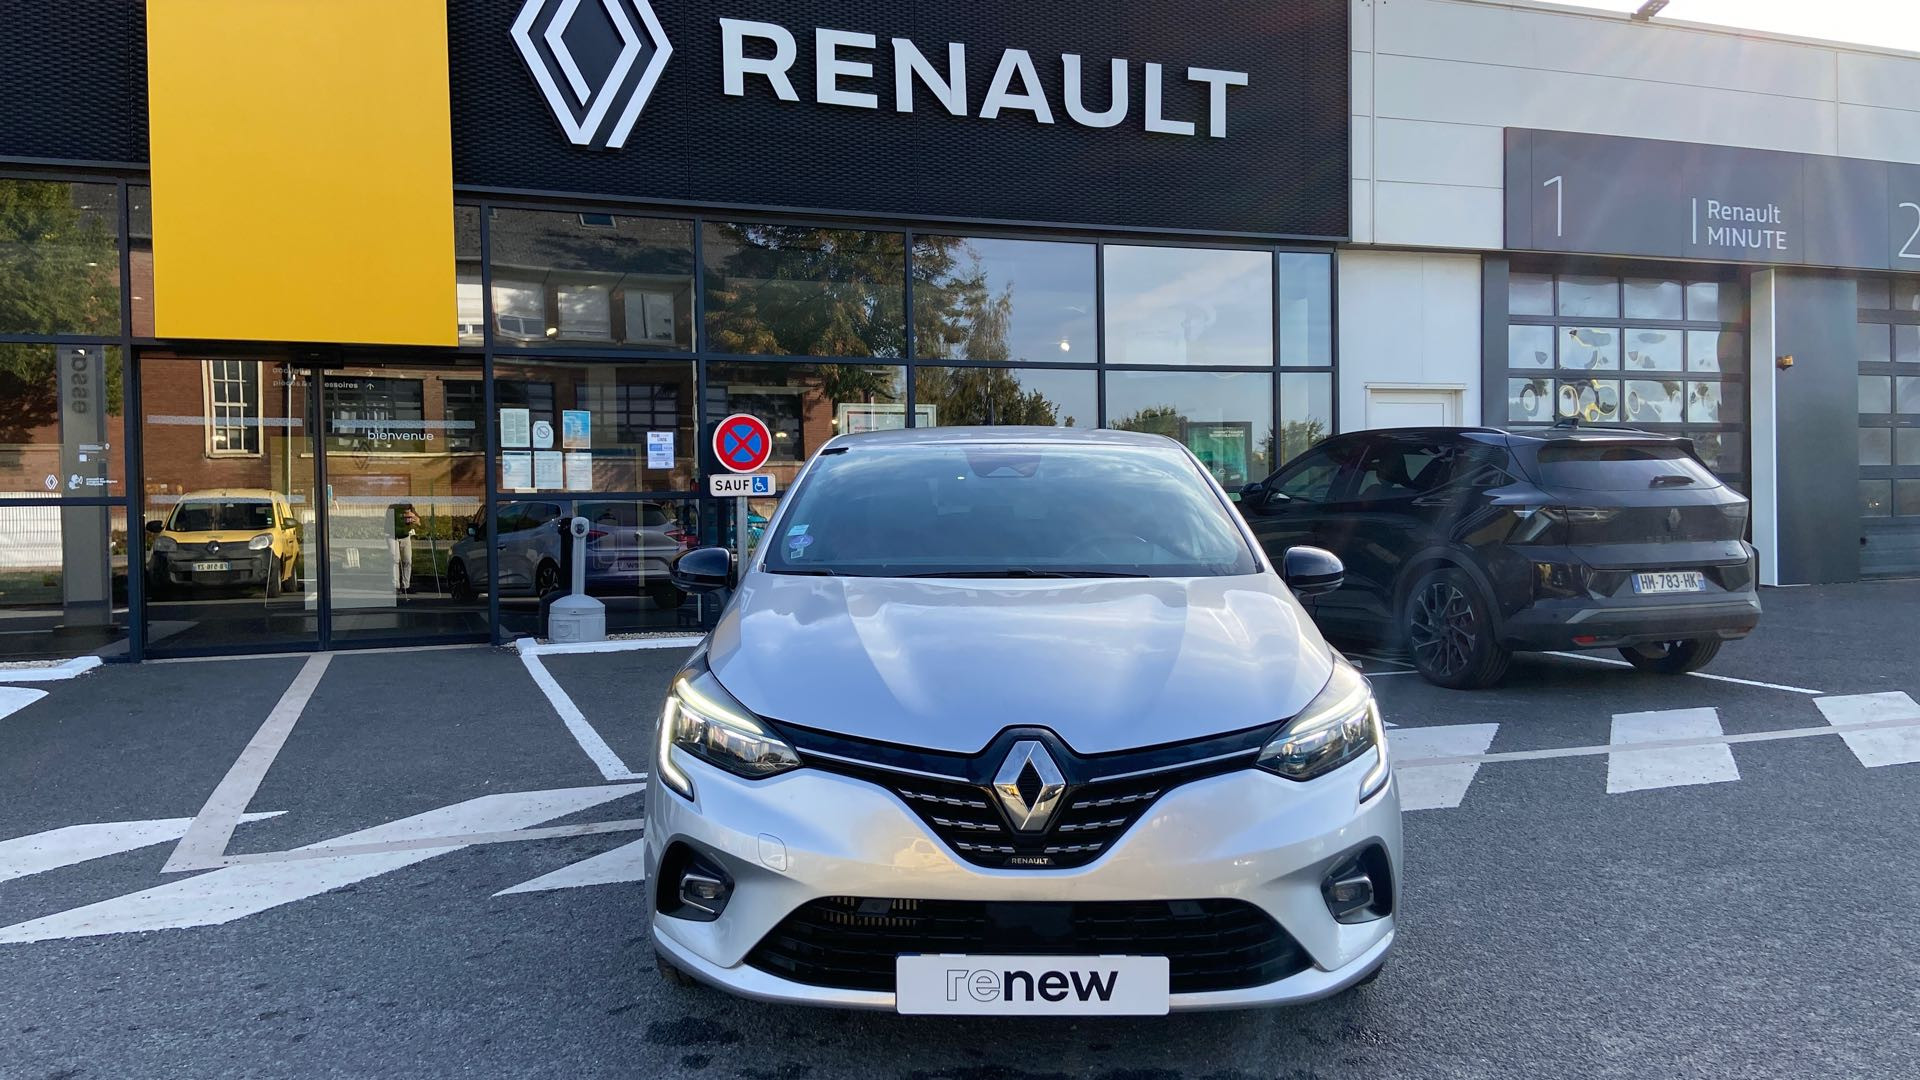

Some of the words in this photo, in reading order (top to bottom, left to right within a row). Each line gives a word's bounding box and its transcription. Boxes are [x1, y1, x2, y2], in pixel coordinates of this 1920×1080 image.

[719, 17, 1249, 138] RENAULT
[1543, 175, 1563, 237] 1
[1707, 199, 1782, 224] Renault
[1708, 226, 1788, 250] MINUTE
[1898, 202, 1920, 258] 2
[367, 429, 434, 441] bienvenue
[715, 479, 750, 491] SAUF
[1640, 573, 1698, 590] HM-783-HK
[1011, 857, 1049, 865] RENAULT
[946, 969, 1118, 1002] renew
